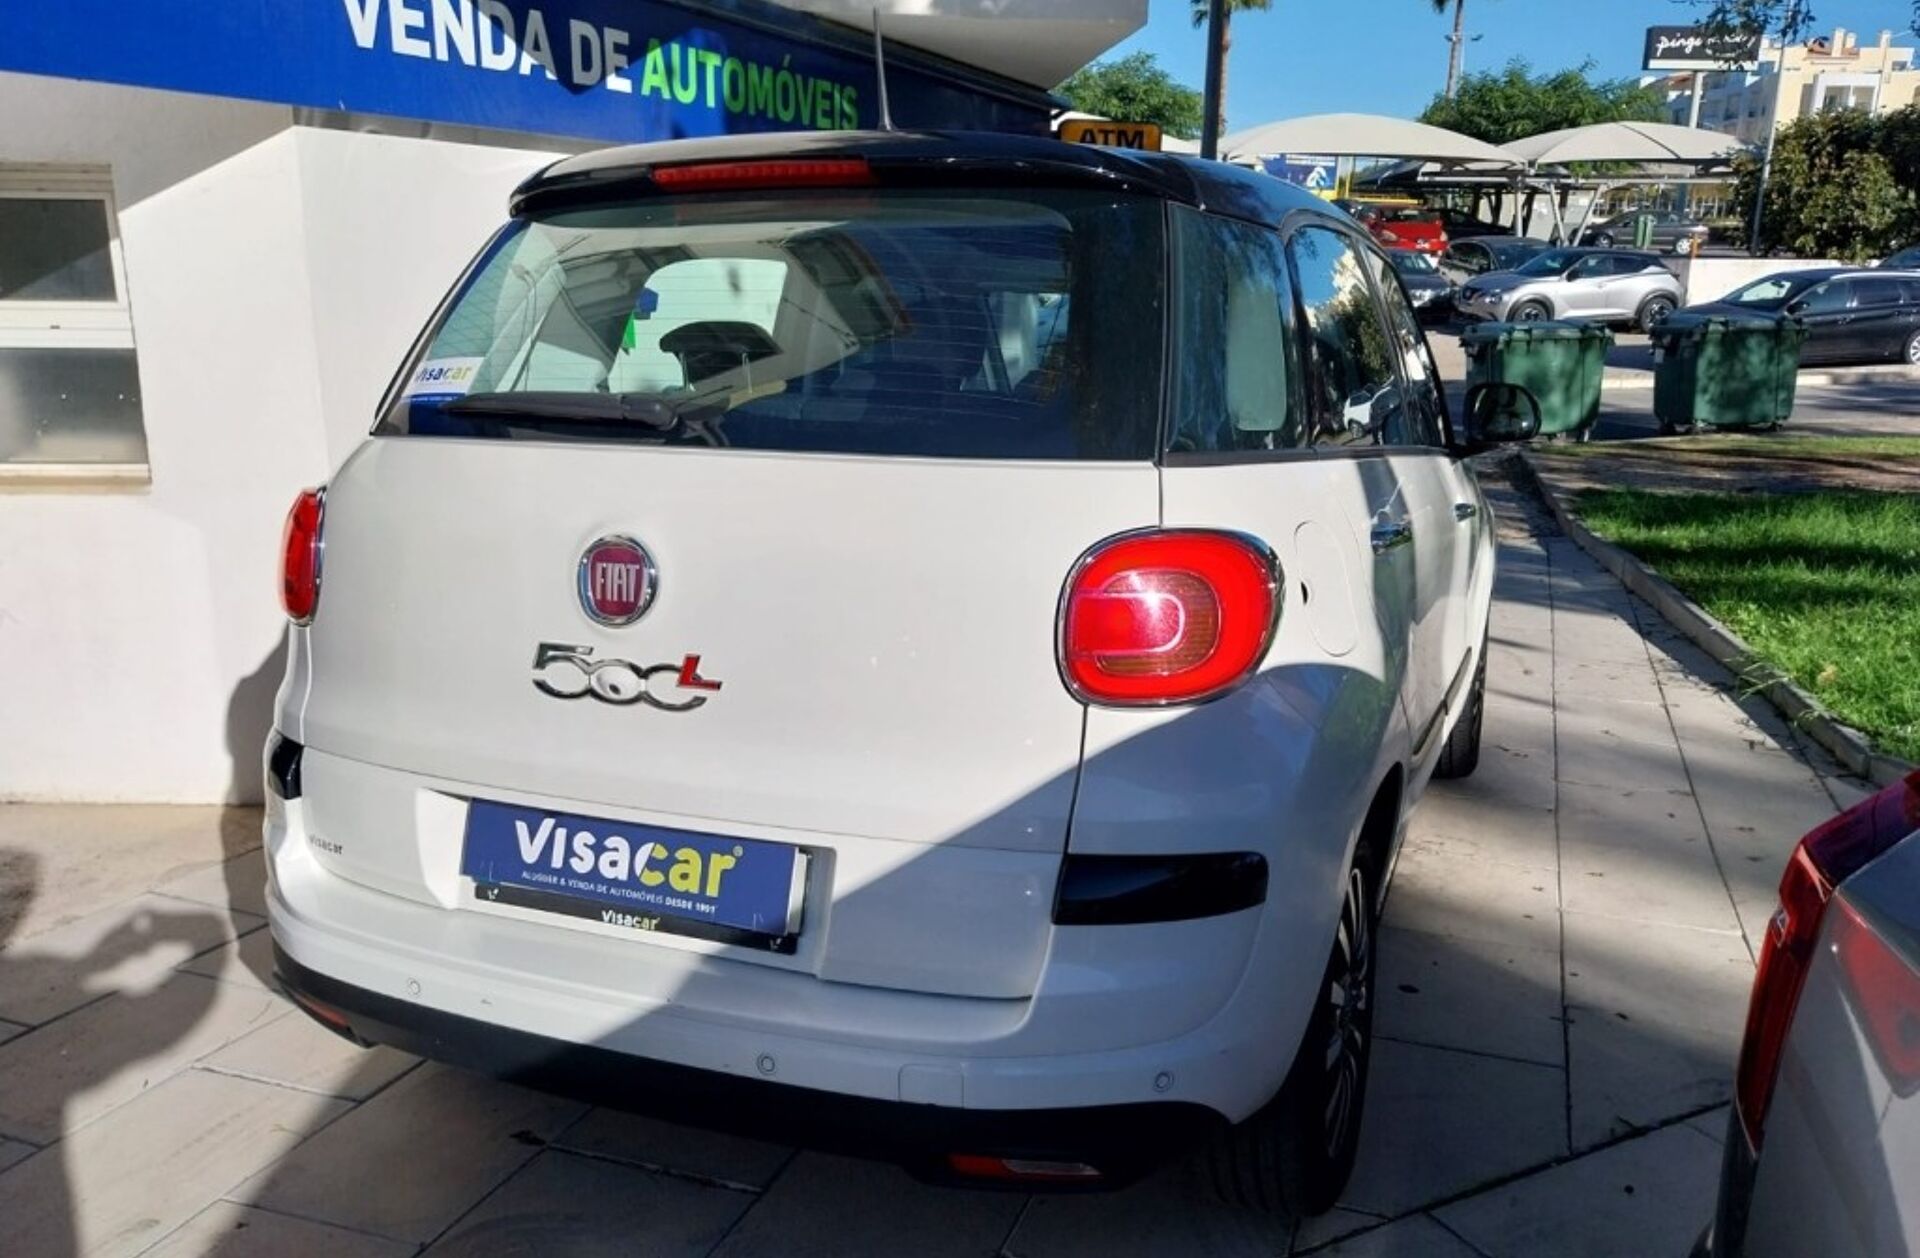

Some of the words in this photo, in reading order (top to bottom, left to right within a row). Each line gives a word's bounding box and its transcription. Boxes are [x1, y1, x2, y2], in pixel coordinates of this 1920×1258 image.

[343, 0, 558, 81] VENDA
[570, 18, 632, 94] DE
[641, 38, 858, 130] AUTOMÓVEIS
[1080, 128, 1144, 149] ATM
[595, 562, 640, 603] FIAT
[559, 876, 567, 887] &
[568, 878, 595, 892] VENDA
[596, 883, 609, 895] DE
[665, 896, 694, 913] DESDE
